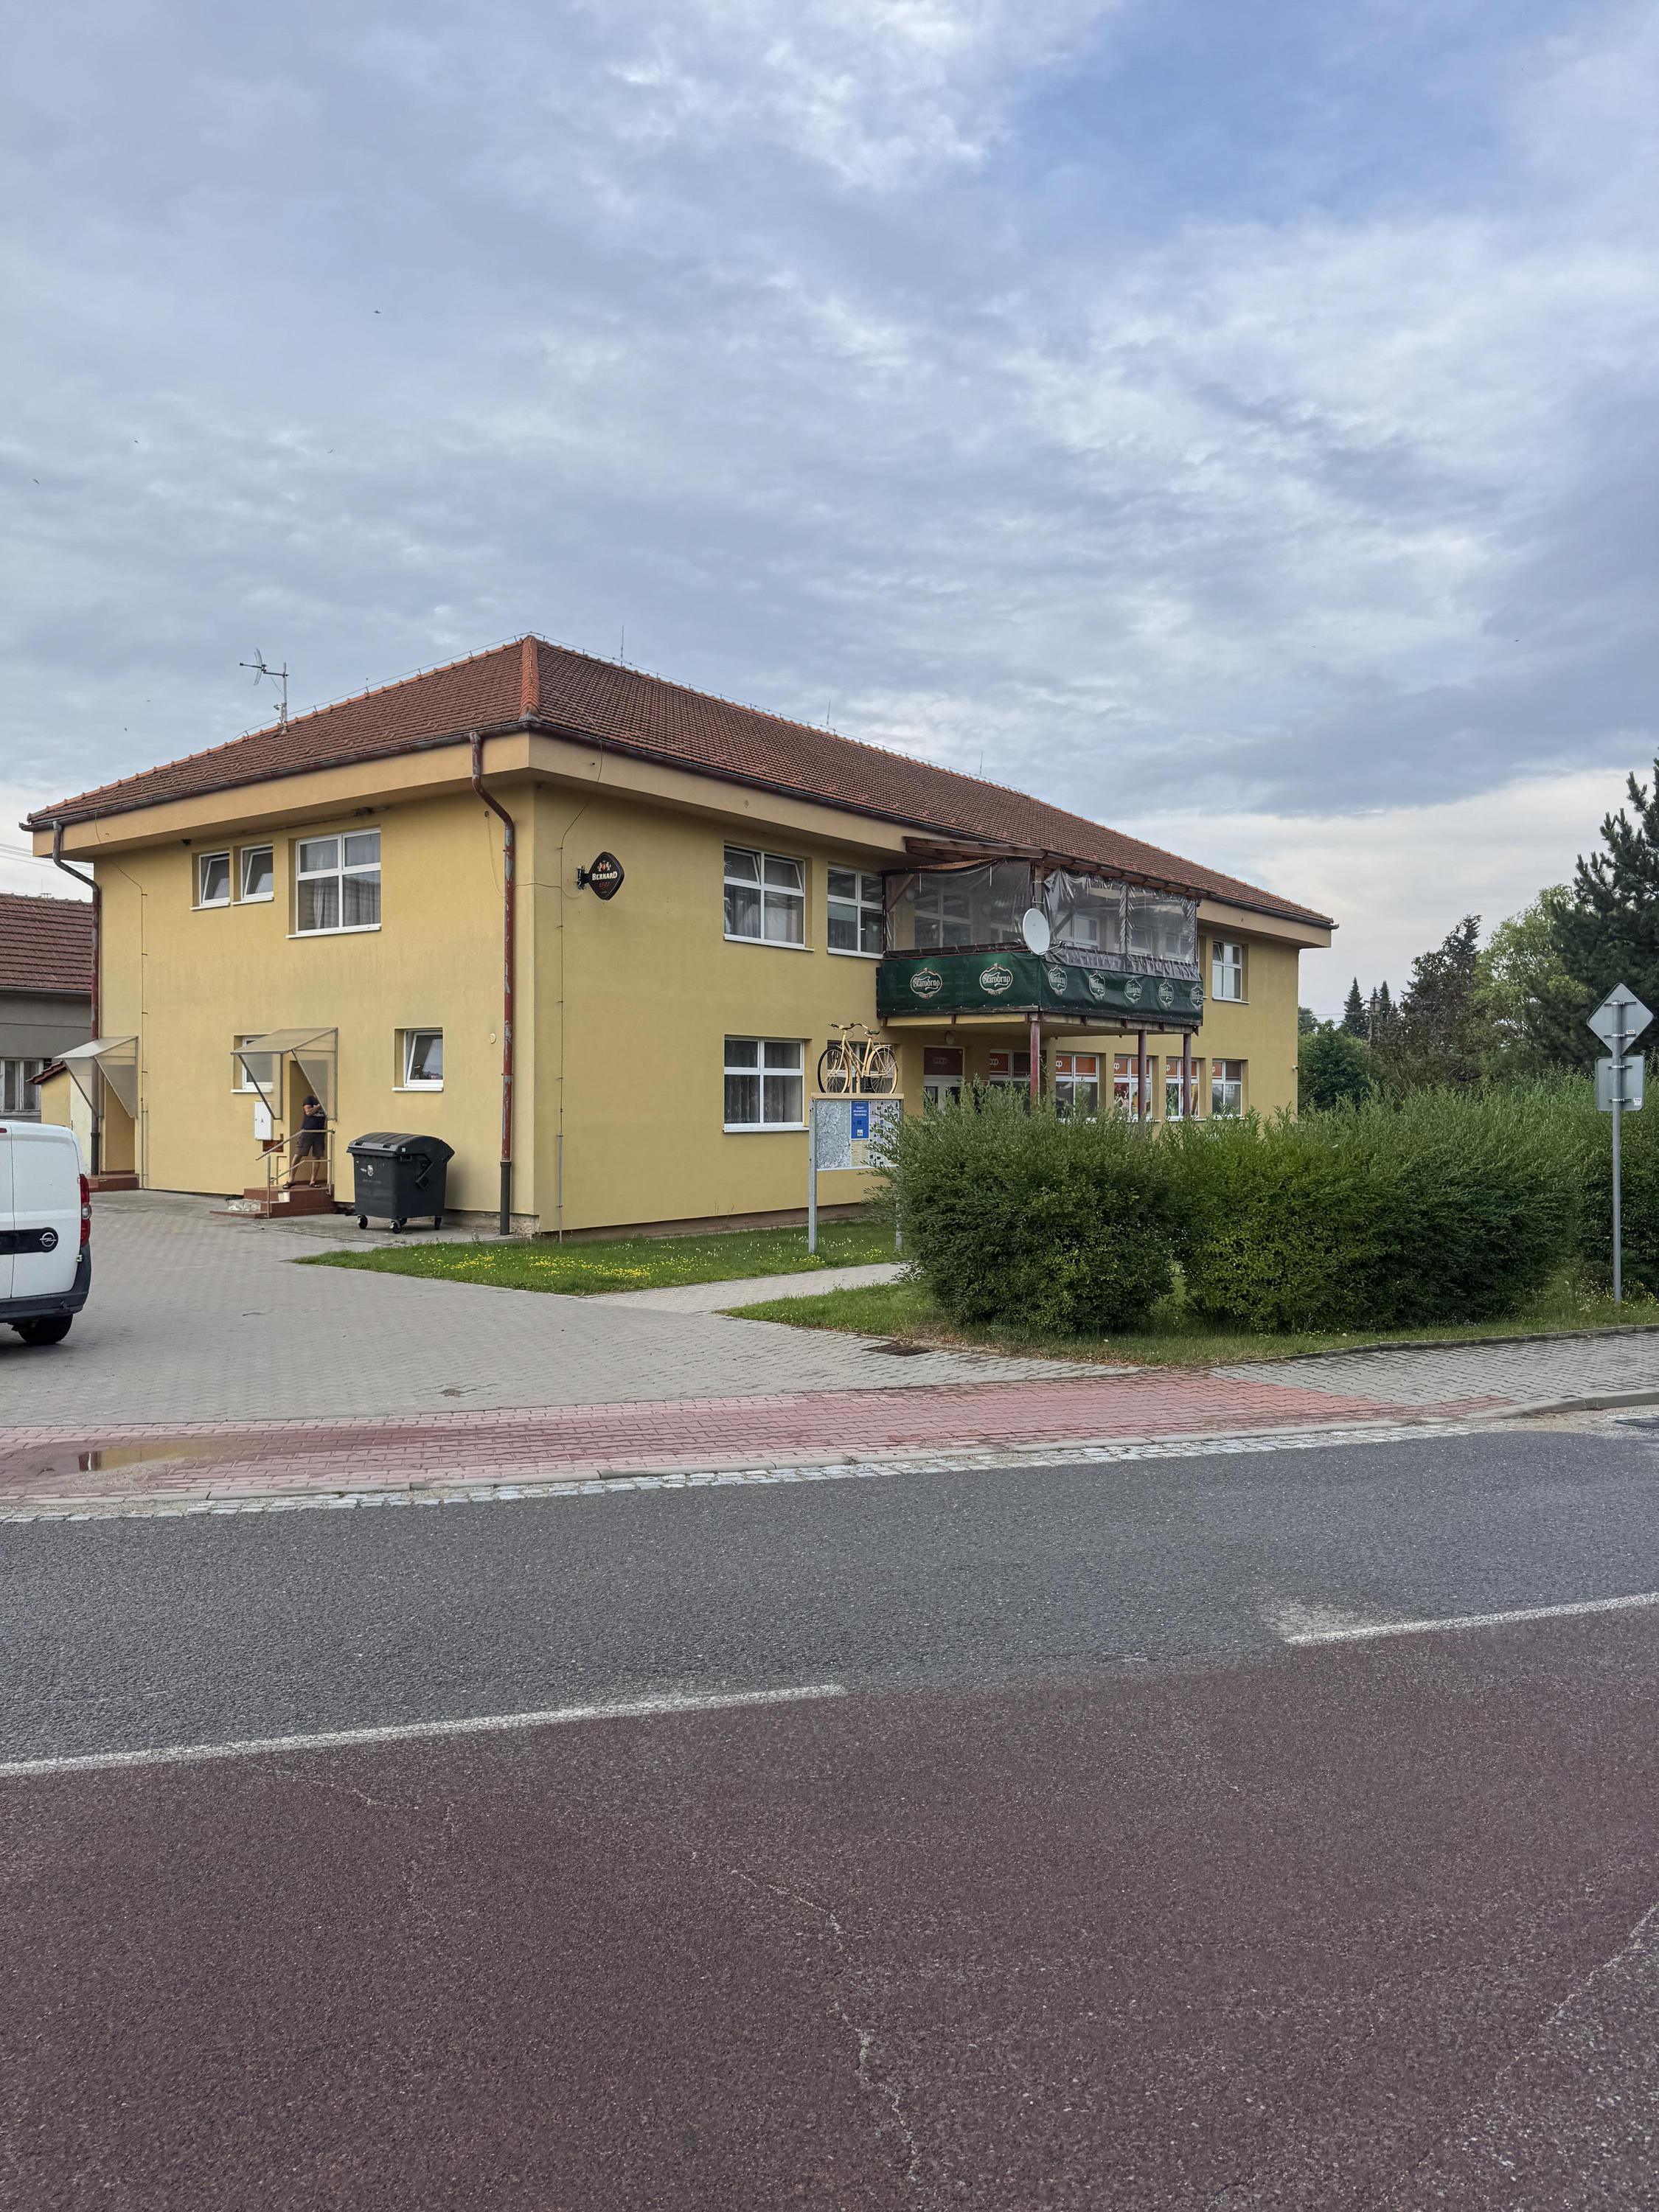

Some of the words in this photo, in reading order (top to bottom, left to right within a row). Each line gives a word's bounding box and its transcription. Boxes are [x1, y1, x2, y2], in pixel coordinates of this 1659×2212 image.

[592, 871, 617, 881] BERNARD
[912, 976, 940, 990] Starobrno
[982, 972, 1011, 987] Starobrno
